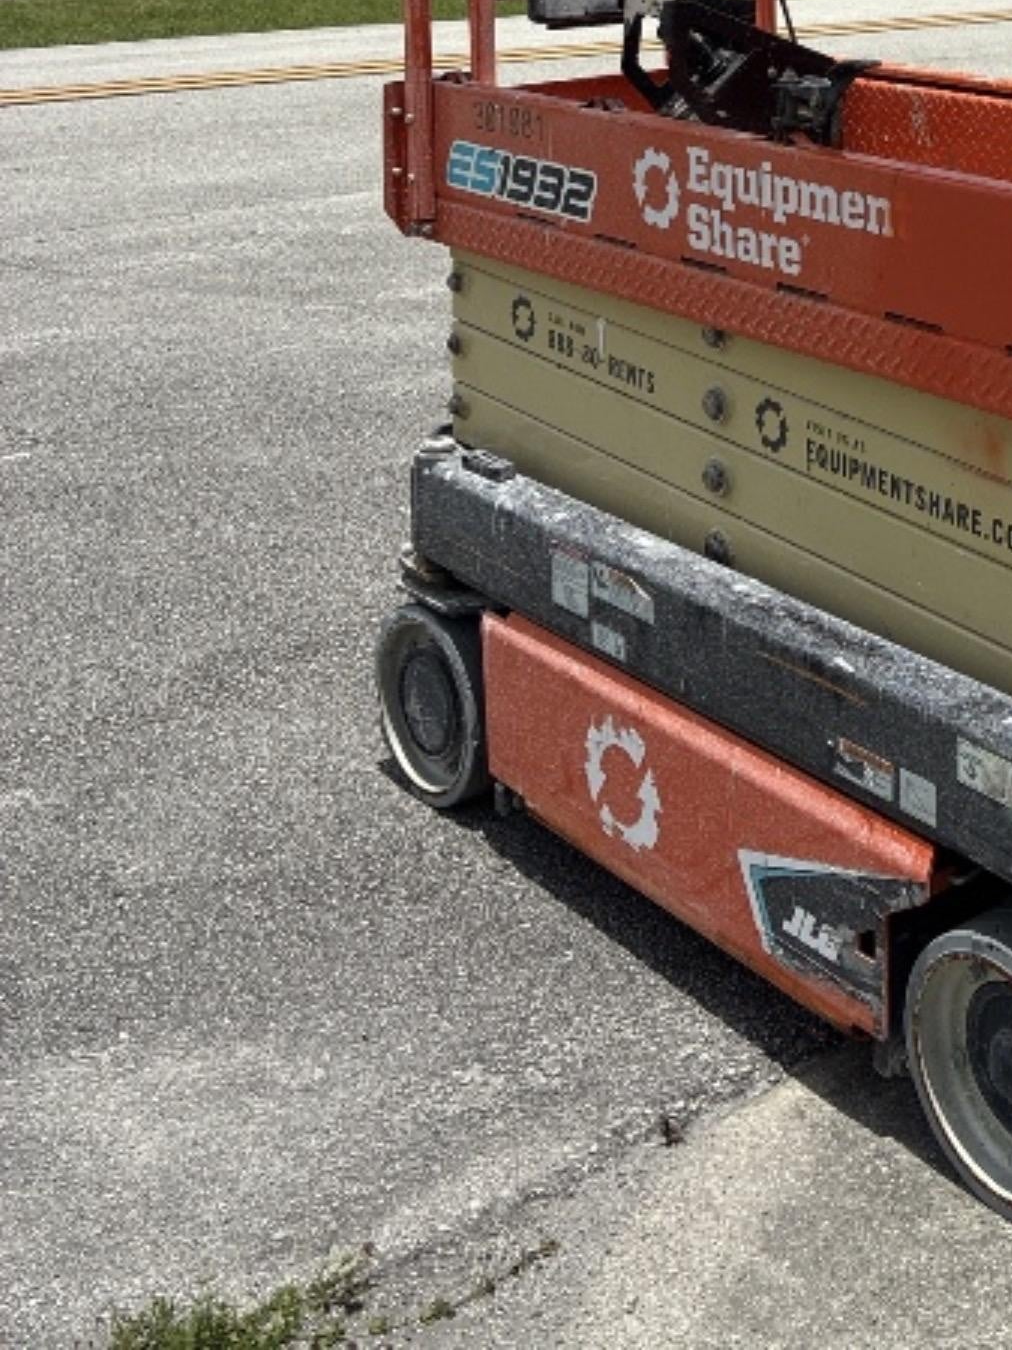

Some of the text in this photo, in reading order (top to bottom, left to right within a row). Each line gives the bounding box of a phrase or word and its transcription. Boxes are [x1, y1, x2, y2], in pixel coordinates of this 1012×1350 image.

[447, 140, 598, 223] ES1932
[686, 146, 894, 237] Equipmen
[687, 203, 801, 276] Share
